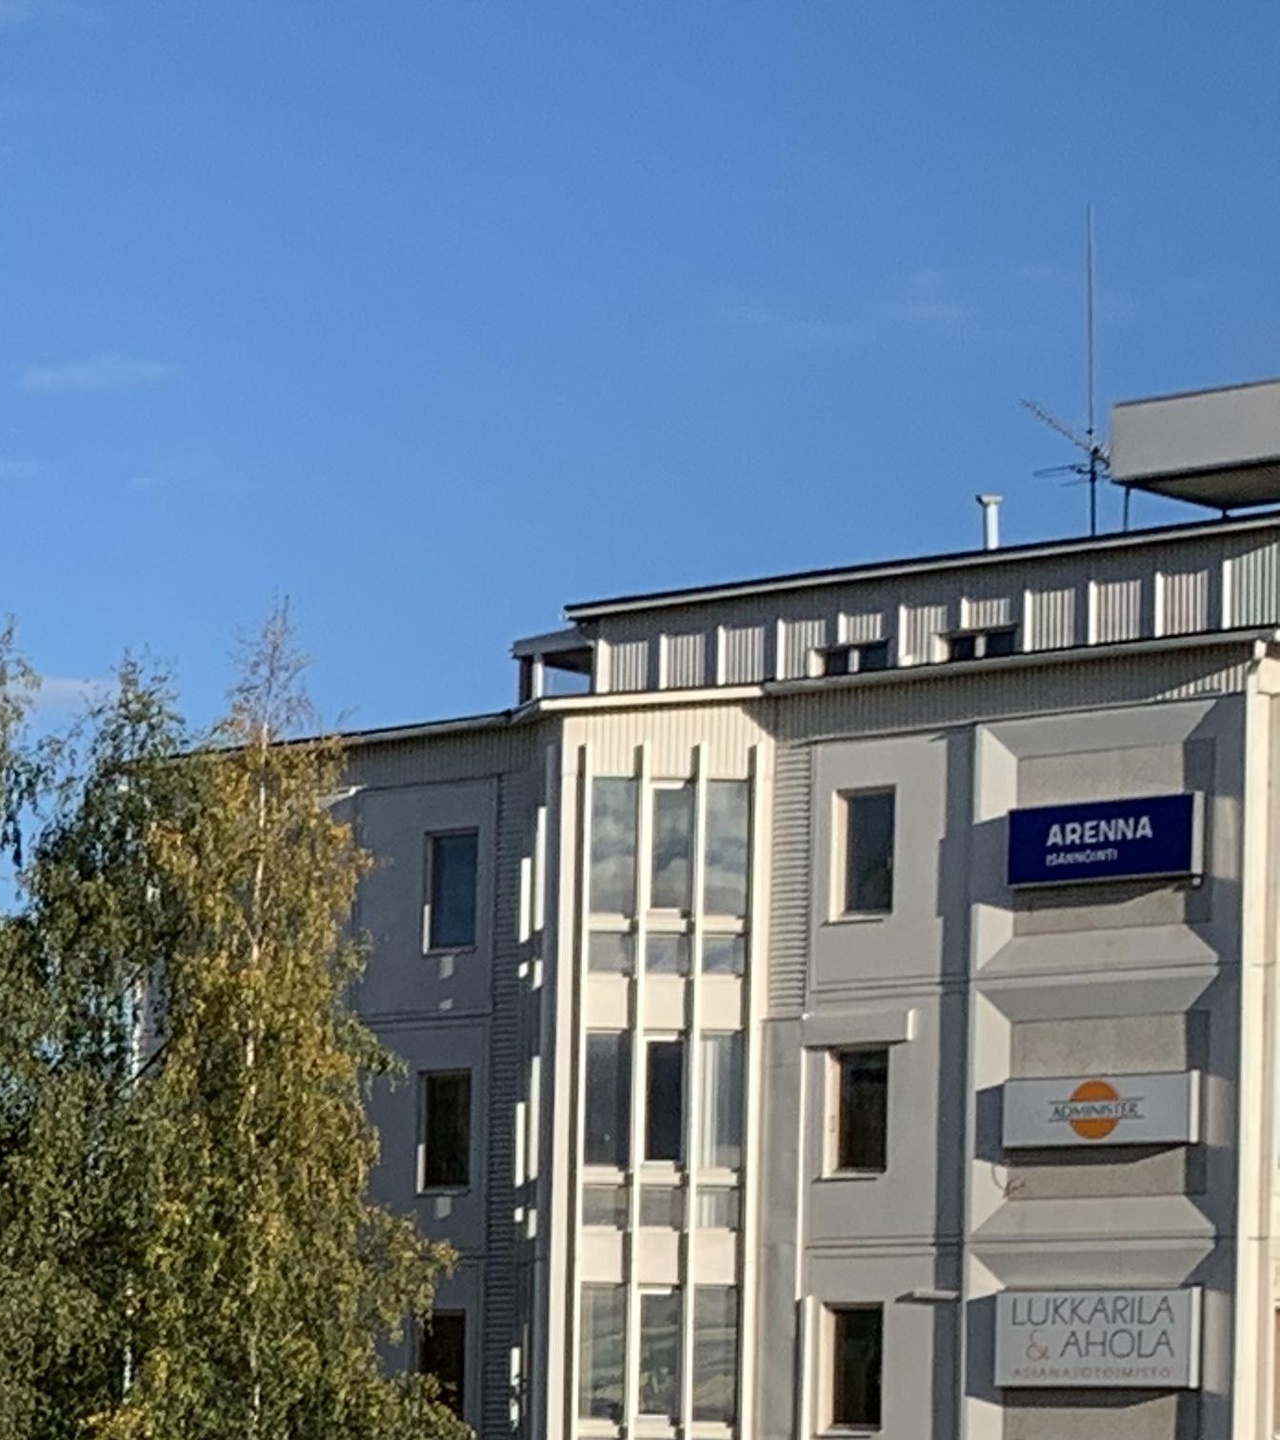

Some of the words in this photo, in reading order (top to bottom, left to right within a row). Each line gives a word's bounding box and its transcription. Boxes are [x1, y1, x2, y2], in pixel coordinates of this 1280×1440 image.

[1045, 815, 1153, 848] ARENNA
[1012, 1296, 1175, 1326] LUKKARILA
[1026, 1329, 1050, 1361] &
[1059, 1329, 1175, 1359] AHOLA
